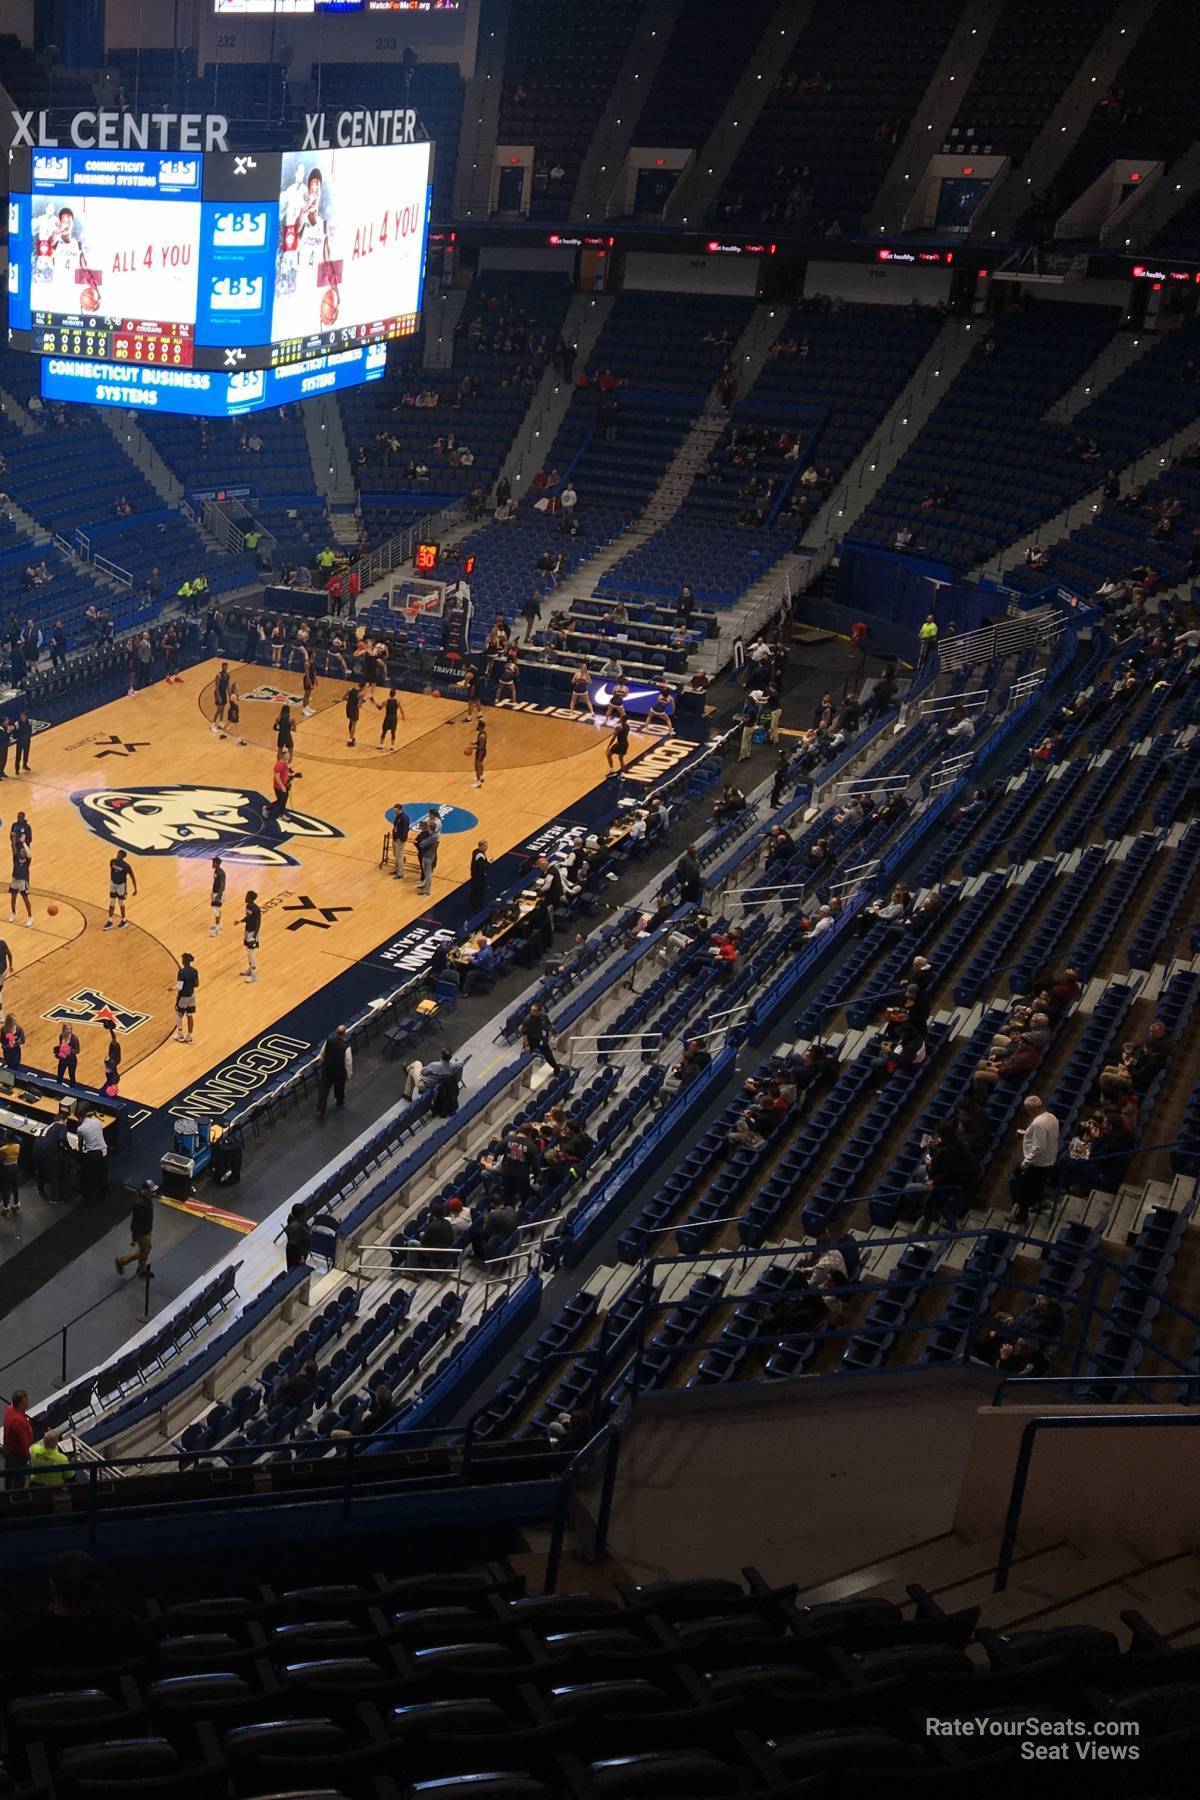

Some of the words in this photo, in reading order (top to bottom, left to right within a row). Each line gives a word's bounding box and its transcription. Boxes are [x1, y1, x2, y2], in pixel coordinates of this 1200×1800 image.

[217, 35, 236, 47] 232
[11, 111, 58, 147] XL
[71, 112, 228, 152] CENTER
[302, 113, 330, 149] XL
[337, 109, 416, 147] CENTER
[85, 161, 145, 172] CONNECTICUT
[233, 156, 257, 175] XL
[74, 174, 115, 185] BUSINESS
[117, 175, 156, 187] SYSTEMS
[352, 222, 374, 261] ALL
[379, 210, 389, 247] 4
[395, 202, 419, 240] YOU
[112, 252, 137, 273] ALL
[143, 245, 153, 268] 4
[161, 244, 191, 268] YOU
[89, 318, 97, 328] 0
[127, 321, 134, 331] 0
[136, 325, 162, 334] COUGARS
[360, 325, 367, 336] 0
[62, 334, 68, 344] 0
[74, 335, 81, 345] 0
[87, 337, 93, 346] 0
[99, 338, 106, 347] 0
[329, 332, 335, 343] 0
[135, 341, 142, 351] 0
[148, 342, 155, 352] 0
[162, 343, 169, 353] 0
[174, 344, 181, 354] 0
[224, 349, 246, 366] XL
[49, 360, 140, 382] CONNECTICUT
[142, 369, 211, 390] BUSINESS
[302, 371, 336, 393] SYSTEMS
[96, 385, 158, 405] SYSTEMS
[420, 545, 437, 554] 15:48
[418, 553, 434, 567] 30
[433, 665, 466, 676] TRAVELER
[495, 698, 676, 736] HUSES
[623, 739, 700, 782] UCONN
[526, 825, 567, 851] HEALTH
[380, 927, 430, 960] HEALTH
[393, 928, 456, 972] UCONN
[168, 1034, 311, 1121] UCONN
